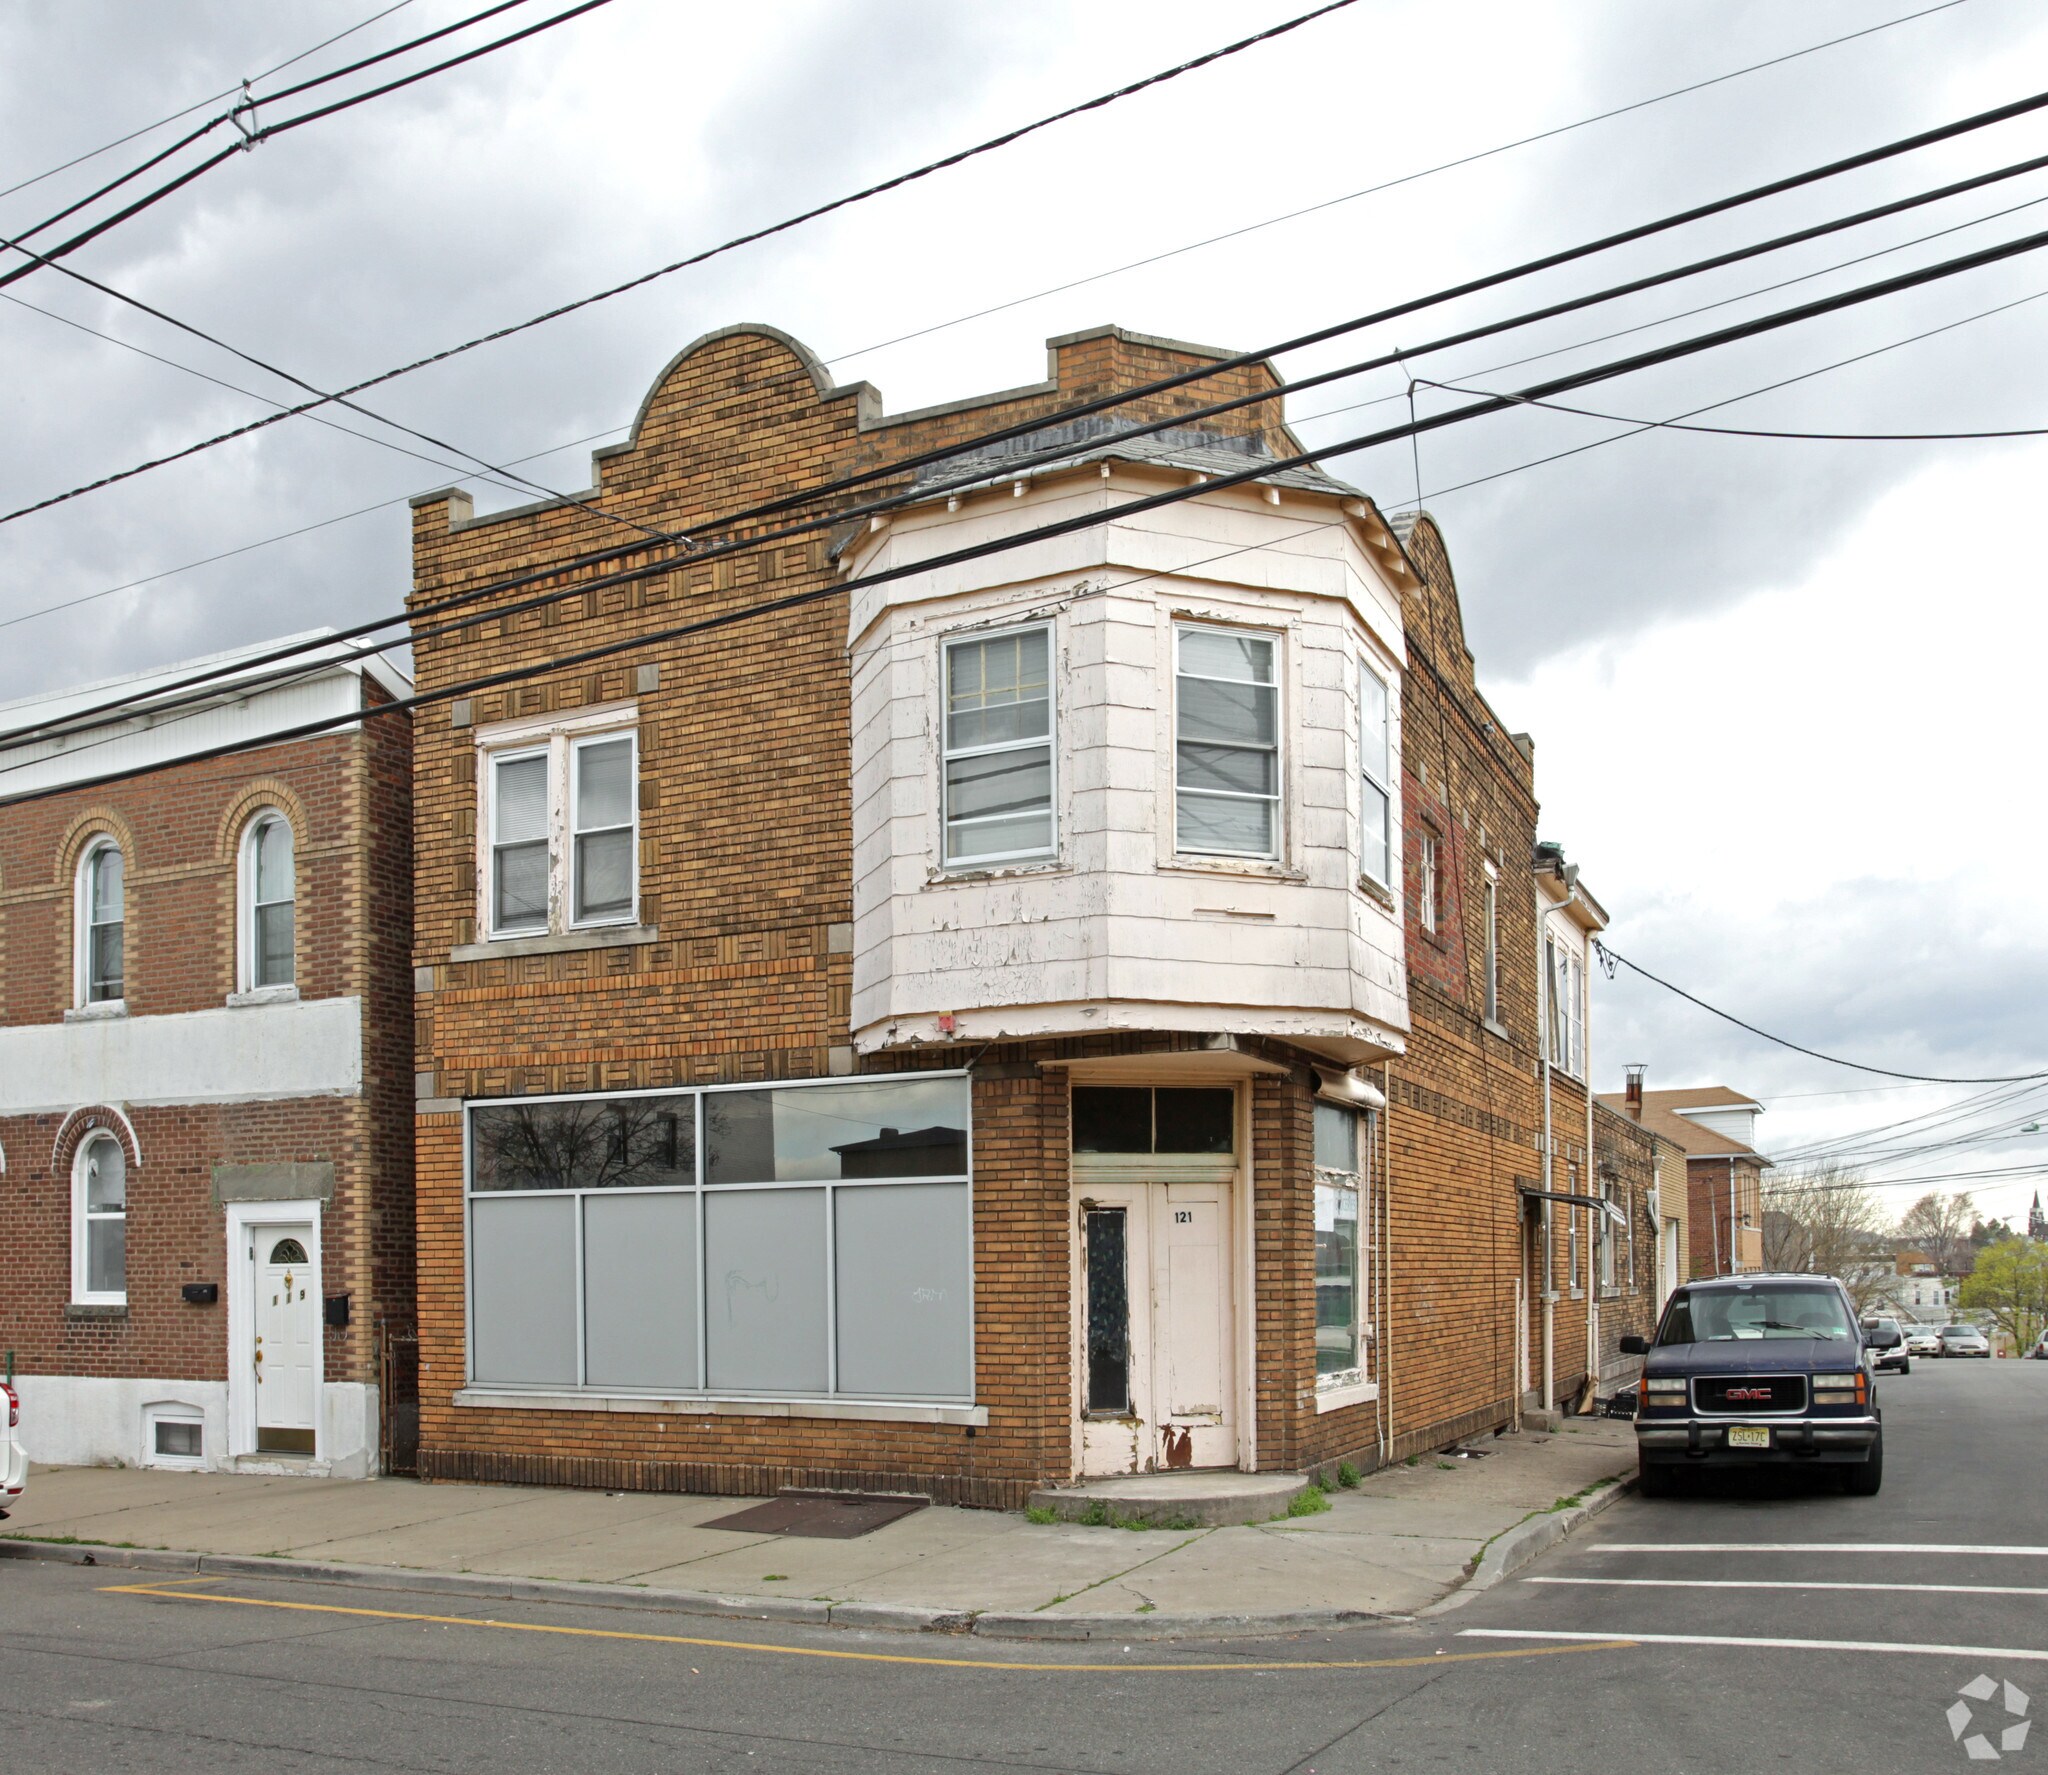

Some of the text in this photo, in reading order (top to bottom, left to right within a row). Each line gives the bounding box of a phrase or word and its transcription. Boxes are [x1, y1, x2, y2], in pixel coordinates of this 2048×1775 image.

[1175, 1211, 1192, 1224] 121
[272, 1289, 306, 1307] 119
[1726, 1388, 1772, 1400] GMC
